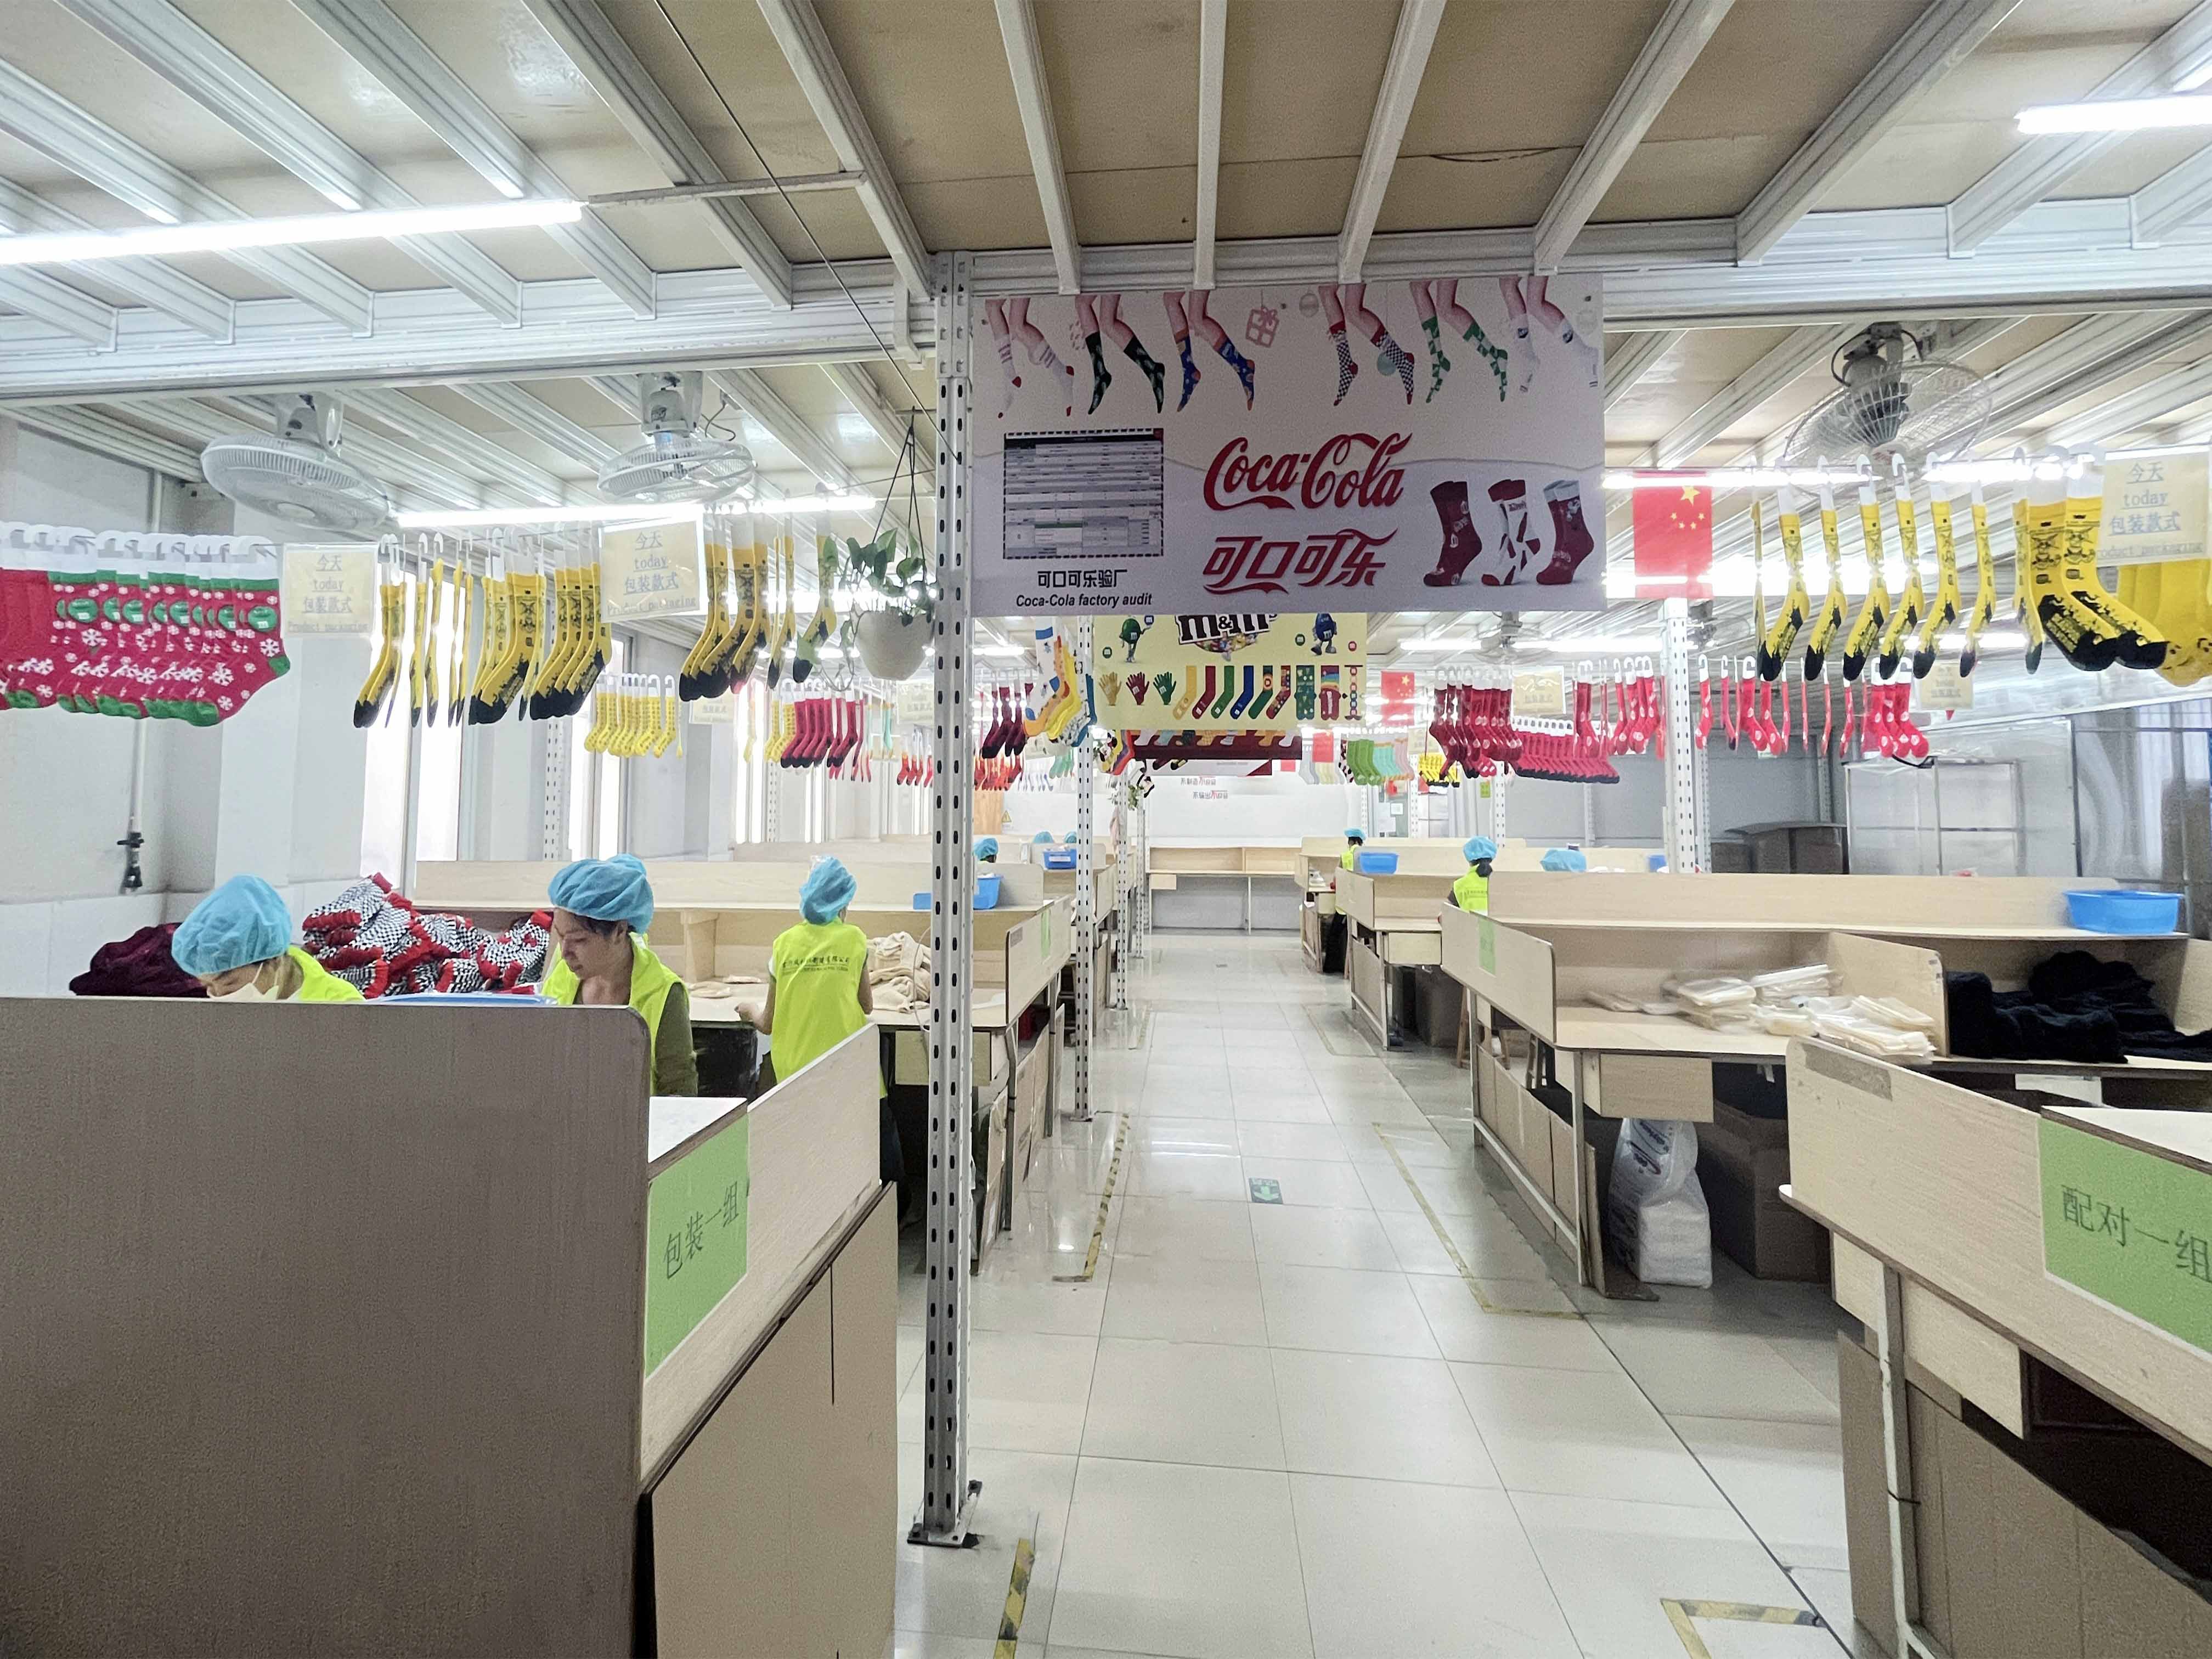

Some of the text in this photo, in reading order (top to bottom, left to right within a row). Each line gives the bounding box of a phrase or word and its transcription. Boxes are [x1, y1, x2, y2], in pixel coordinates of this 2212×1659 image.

[1204, 432, 1413, 511] Coca-Cola
[2127, 461, 2164, 483] 今天
[2123, 489, 2169, 509] today
[635, 531, 663, 550] 今天
[317, 553, 343, 571] 今天
[634, 554, 668, 571] today
[1203, 528, 1398, 595] 可口可乐
[312, 576, 344, 592] today
[1037, 569, 1127, 588] 可口可乐验厂
[1017, 592, 1153, 609] Coca-Cola factory audit
[663, 1181, 739, 1279] 包装一组
[2061, 1184, 2212, 1283] 配对一组
